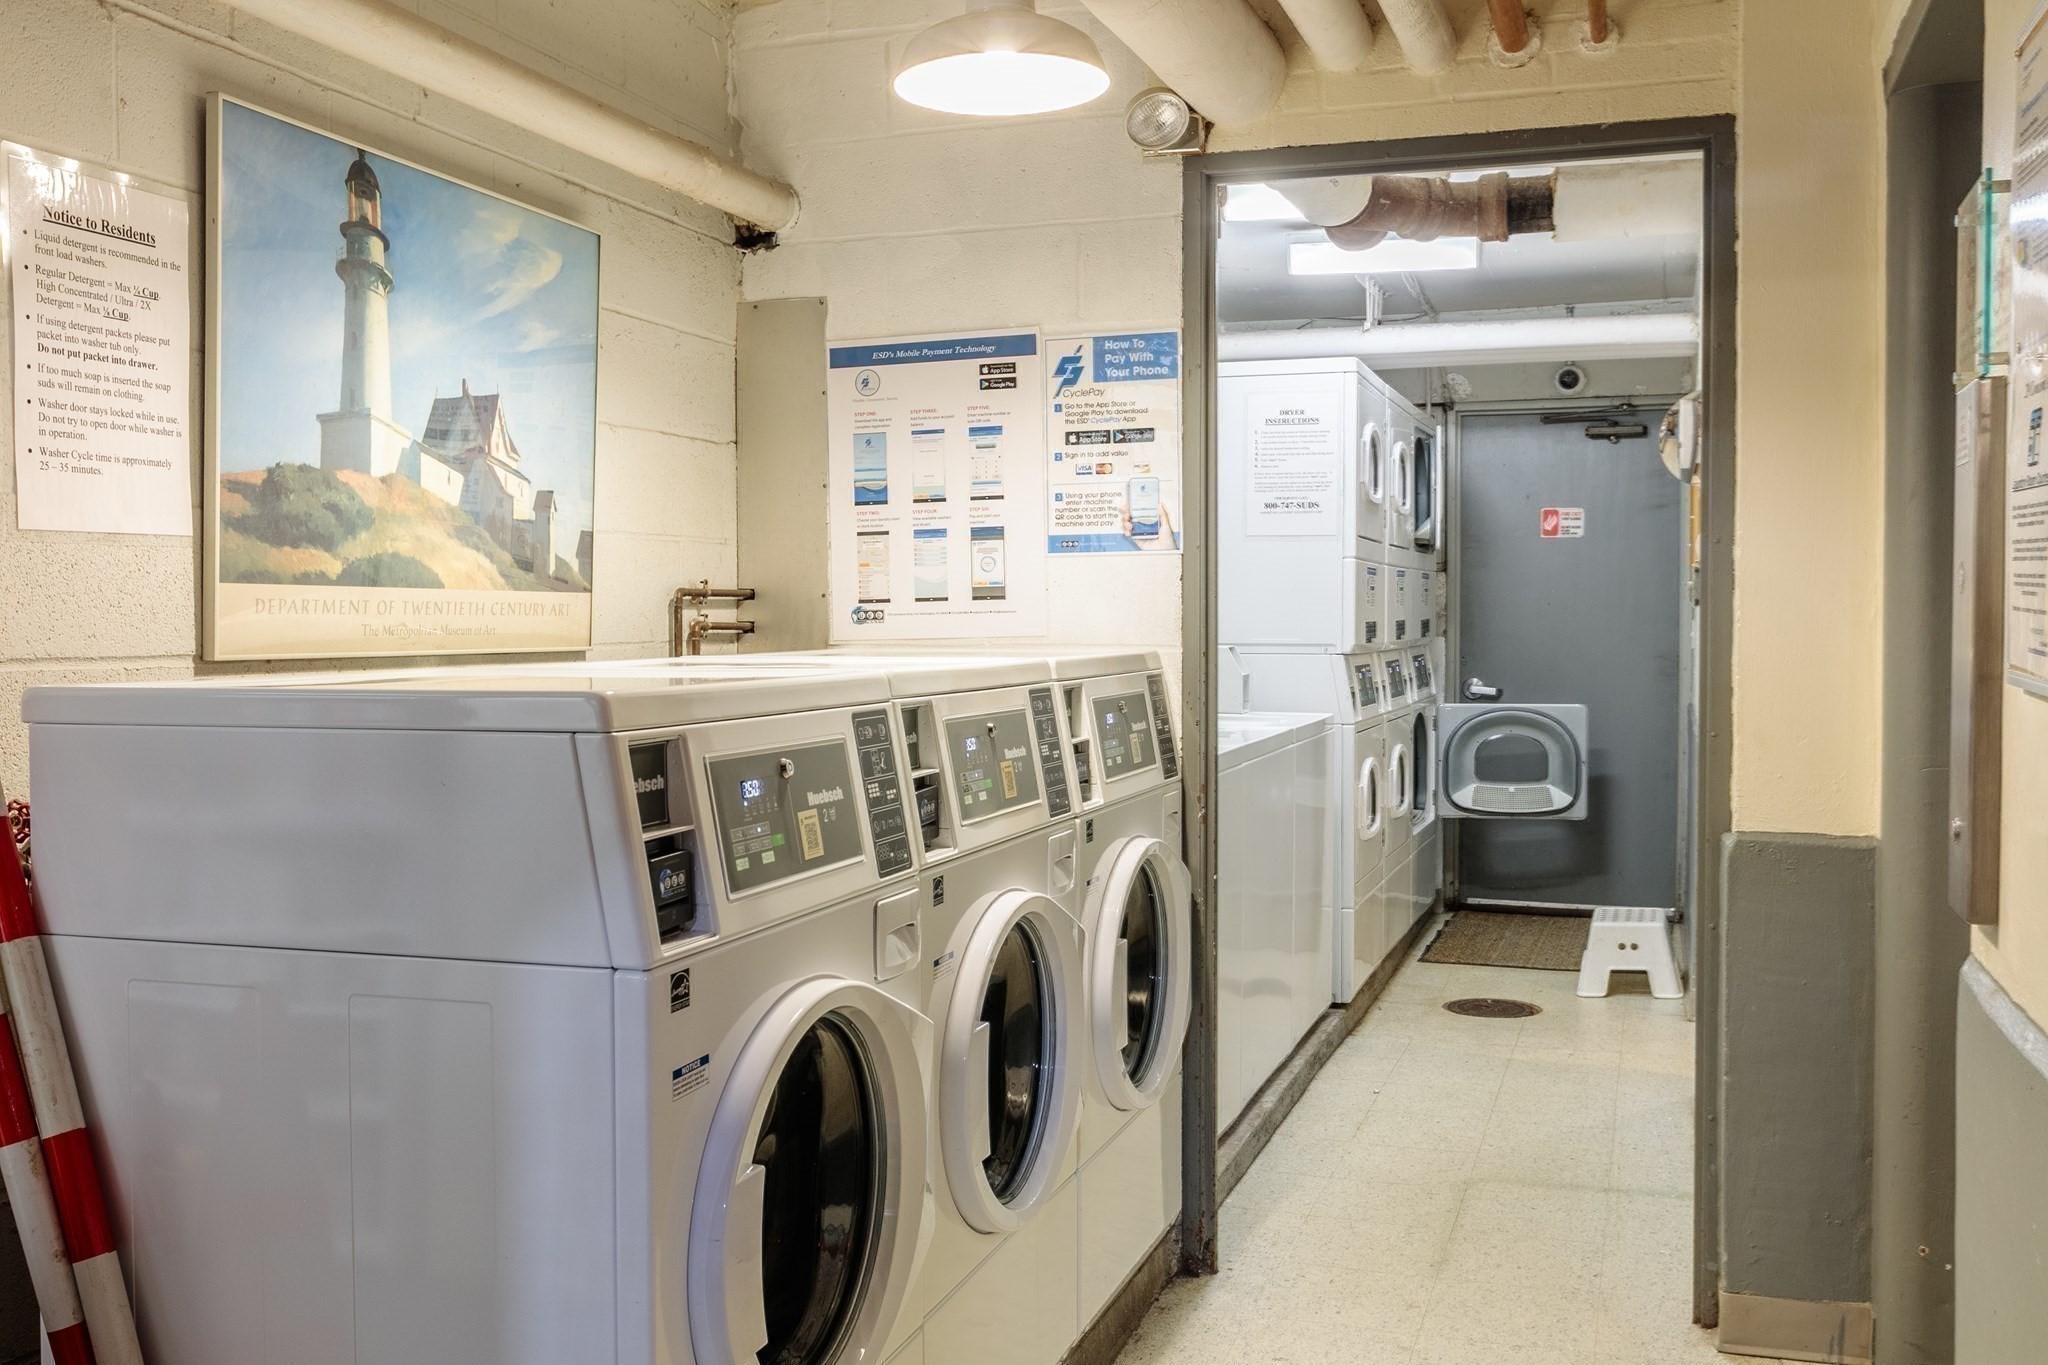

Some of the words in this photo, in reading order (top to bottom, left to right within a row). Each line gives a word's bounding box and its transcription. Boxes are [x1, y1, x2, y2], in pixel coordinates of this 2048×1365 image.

[43, 206, 82, 226] Notice
[85, 216, 97, 230] to
[101, 219, 155, 244] Residents
[34, 228, 60, 244] Liquid
[62, 235, 98, 252] detergent
[108, 248, 159, 266] recommended
[160, 258, 168, 268] in
[169, 260, 180, 271] the
[34, 243, 54, 256] front
[56, 247, 72, 260] load
[74, 254, 107, 268] washers.
[35, 263, 66, 279] Regular
[68, 271, 105, 288] Detergent
[114, 280, 131, 293] Max
[141, 287, 161, 301] Cup.
[36, 278, 55, 293] High
[57, 283, 108, 302] Concentrated
[114, 294, 133, 307] Ultra
[139, 299, 151, 310] 2X
[36, 292, 73, 309] Detergent
[83, 302, 100, 314] Max
[112, 308, 131, 322] Cup.
[36, 313, 45, 323] If
[45, 317, 66, 330] using
[67, 319, 103, 335] detergent
[104, 328, 132, 339] packets
[133, 331, 156, 344] please
[158, 338, 170, 347] put
[36, 329, 62, 341] packet
[64, 335, 79, 344] into
[80, 337, 107, 349] washer
[109, 341, 121, 351] tub
[122, 344, 141, 356] only.
[896, 349, 920, 358] Mobile
[921, 347, 952, 357] Payment
[954, 344, 996, 354] Technology
[1105, 340, 1130, 350] How
[1132, 338, 1145, 348] To
[37, 342, 49, 353] Do
[51, 347, 64, 355] not
[67, 349, 80, 359] put
[83, 352, 109, 362] packet
[111, 354, 126, 365] into
[128, 357, 157, 370] drawer.
[1104, 353, 1125, 364] Pay
[1128, 351, 1153, 362] With
[37, 362, 45, 372] If
[46, 365, 59, 375] too
[60, 368, 82, 378] much
[83, 372, 101, 383] soap
[111, 376, 140, 387] inserted
[141, 378, 153, 388] the
[154, 382, 171, 393] soap
[1105, 367, 1129, 377] Your
[1132, 365, 1169, 375] Phone
[37, 378, 55, 388] suds
[57, 380, 72, 391] will
[74, 384, 100, 394] remain
[102, 388, 111, 396] on
[113, 388, 144, 403] clothing.
[1062, 388, 1105, 398] CyclePay
[38, 397, 68, 410] Washer
[69, 401, 87, 412] door
[89, 406, 108, 417] stays
[109, 406, 133, 418] locked
[135, 410, 155, 421] while
[165, 416, 180, 424] use.
[1064, 410, 1089, 418] Google
[38, 411, 50, 422] Do
[52, 416, 65, 424] not
[67, 416, 78, 427] try
[79, 418, 88, 426] to
[89, 420, 108, 430] open
[109, 420, 126, 431] door
[128, 422, 148, 433] while
[149, 426, 174, 436] washer
[48, 429, 87, 440] operation.
[39, 446, 69, 458] Washer
[70, 449, 93, 462] Cycle
[95, 453, 112, 462] time
[121, 456, 172, 470] approximately
[1064, 451, 1078, 459] Sign
[39, 460, 49, 470] 25
[59, 462, 68, 472] 35
[70, 465, 103, 475] minutes.
[255, 597, 370, 615] DEPARTMENT
[377, 599, 395, 616] OF
[401, 600, 485, 616] TWENTIETH
[490, 601, 546, 617] CENTURY
[549, 602, 570, 617] ART
[362, 624, 380, 637] The
[382, 624, 438, 639] Metropolitan
[440, 624, 473, 637] Museum
[474, 624, 482, 636] of
[483, 624, 496, 636] Art
[807, 786, 844, 806] Huebsch
[681, 1059, 701, 1075] NOTICE
